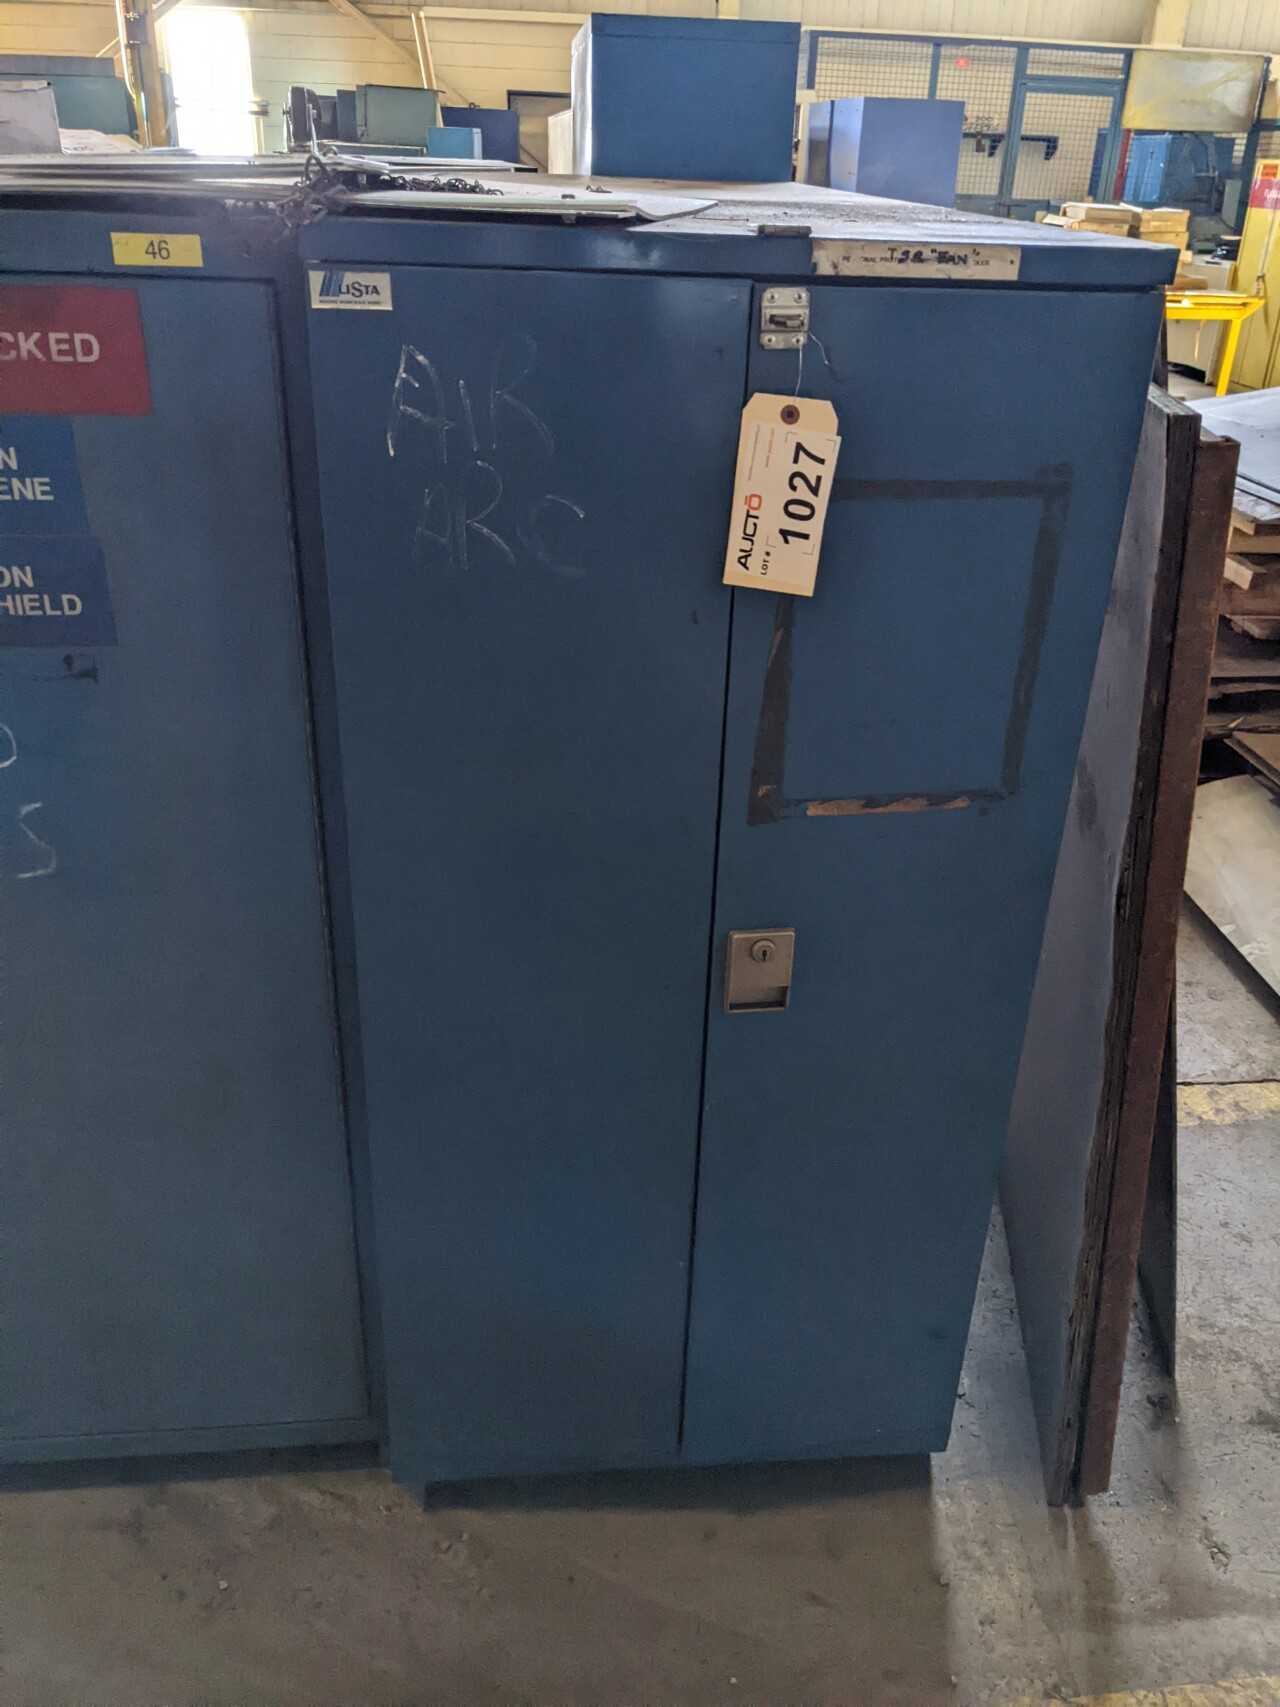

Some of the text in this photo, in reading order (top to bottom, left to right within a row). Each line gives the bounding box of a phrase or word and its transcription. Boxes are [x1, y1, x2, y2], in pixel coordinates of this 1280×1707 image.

[145, 239, 170, 260] 46
[338, 281, 380, 298] LISTA
[778, 441, 826, 545] 1027
